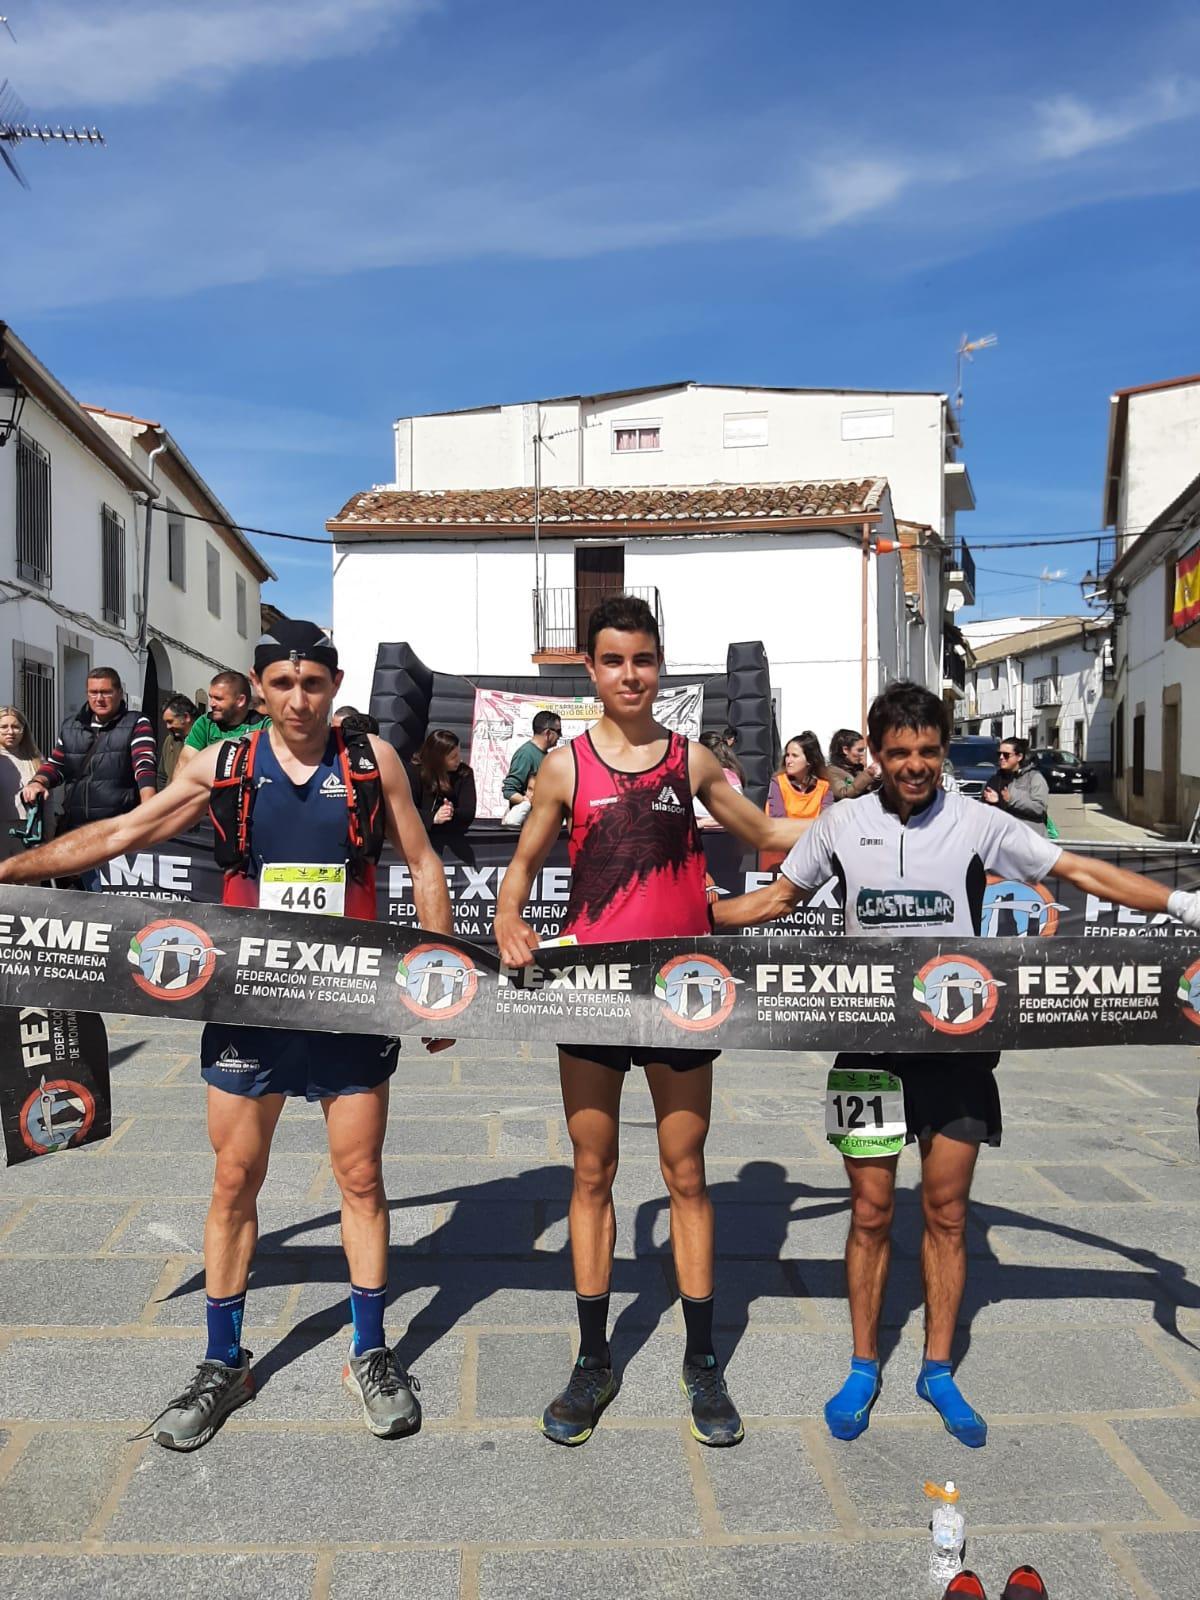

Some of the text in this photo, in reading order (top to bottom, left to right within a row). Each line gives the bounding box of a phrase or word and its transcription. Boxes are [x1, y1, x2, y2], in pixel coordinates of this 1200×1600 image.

[281, 886, 327, 910] 446
[0, 914, 113, 952] EXME
[484, 922, 493, 936] Y
[37, 951, 107, 968] EXTREMEÑA
[238, 936, 383, 977] FEXME
[33, 965, 41, 978] Y
[43, 967, 106, 982] ESCALADA
[236, 969, 378, 991] FEDERACIÓN EXTREMEÑA
[498, 963, 632, 991] FEXME
[756, 964, 896, 994] FEXME
[1018, 965, 1162, 995] FEXME
[234, 984, 376, 1005] DE MONTAÑA Y ESCALADA
[497, 990, 632, 1005] FEDERACIÓN EXTREMEÑA
[757, 994, 896, 1008] FEDERACIÓN EXTREMEÑA
[1019, 996, 1159, 1009] FEDERACIÓN EXTREMEÑA
[496, 1002, 632, 1018] DE MONTAÑA Y ESCALADA
[757, 1009, 896, 1023] DE MONTAÑA Y ESCALADA
[1019, 1010, 1158, 1023] DE MONTAÑA Y ESCALADA
[69, 1047, 80, 1059] DE
[833, 1094, 884, 1129] 121
